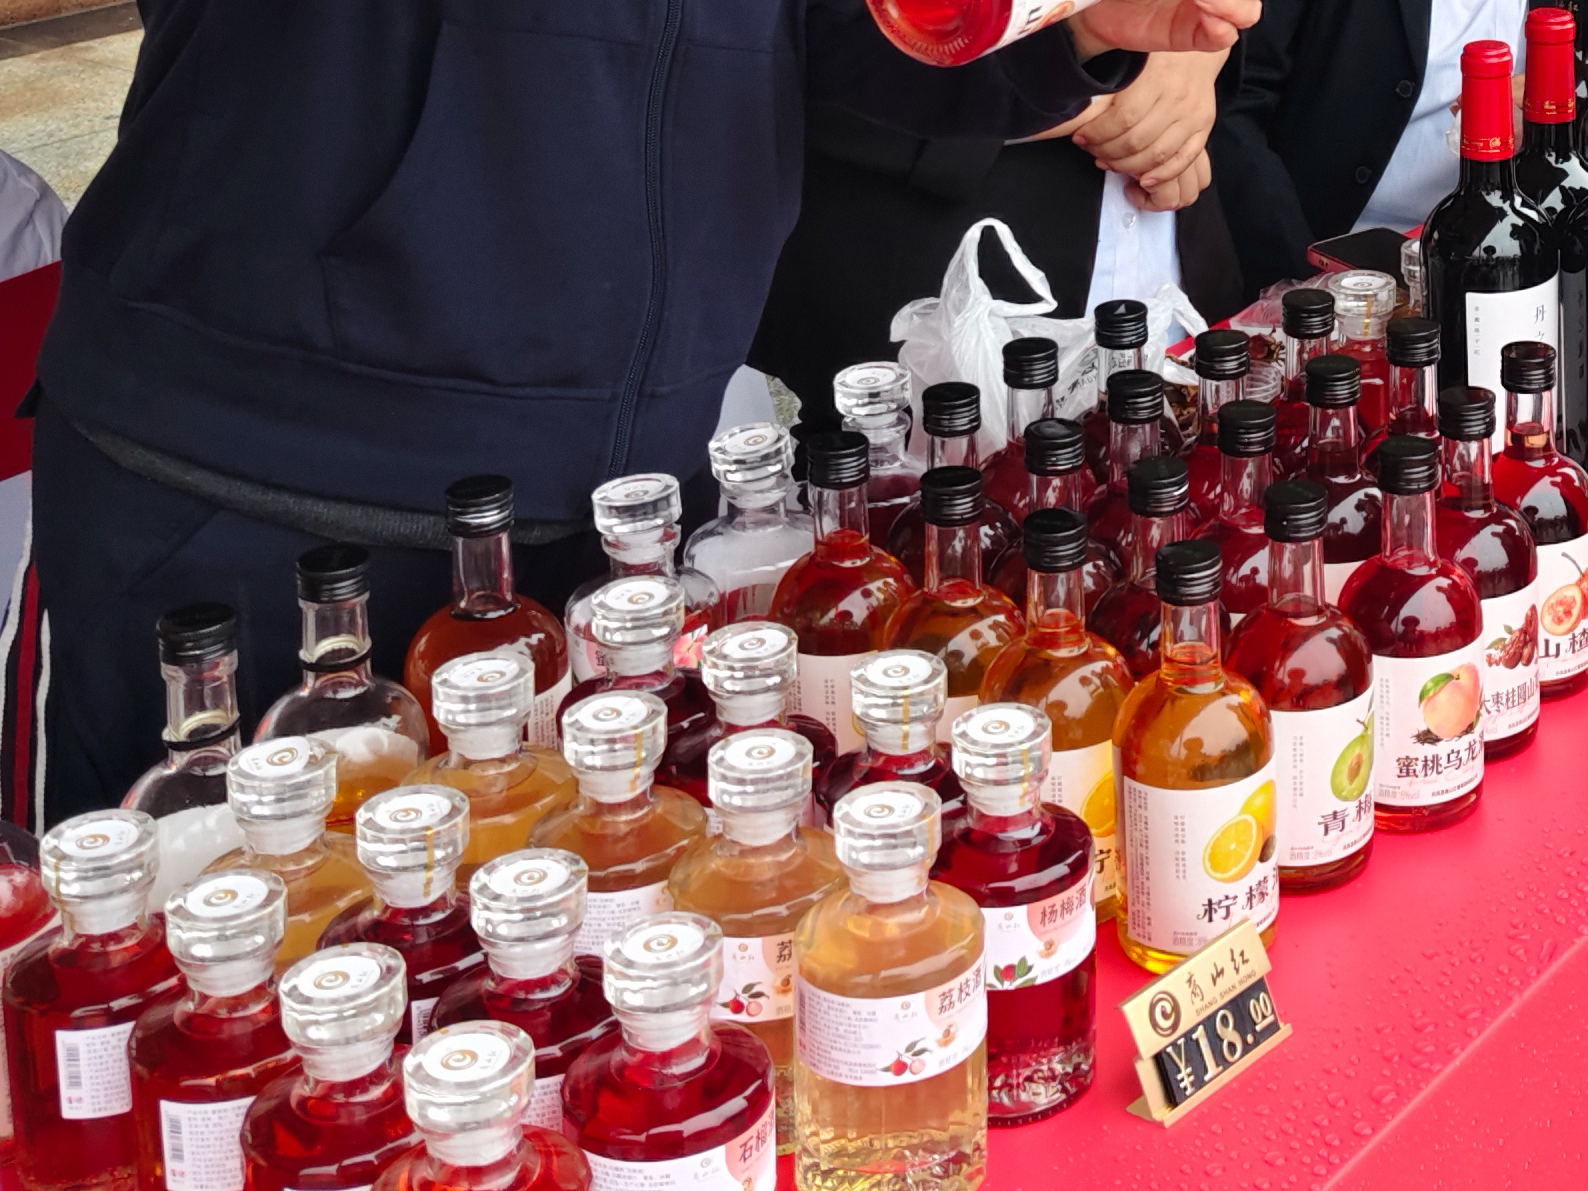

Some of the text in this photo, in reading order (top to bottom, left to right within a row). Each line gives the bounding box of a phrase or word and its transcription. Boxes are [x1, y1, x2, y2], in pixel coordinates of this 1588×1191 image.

[1039, 882, 1087, 928] 杨梅酒
[938, 963, 982, 1016] 荔枝酒
[1195, 969, 1257, 1017] SHANG SHAN HONG
